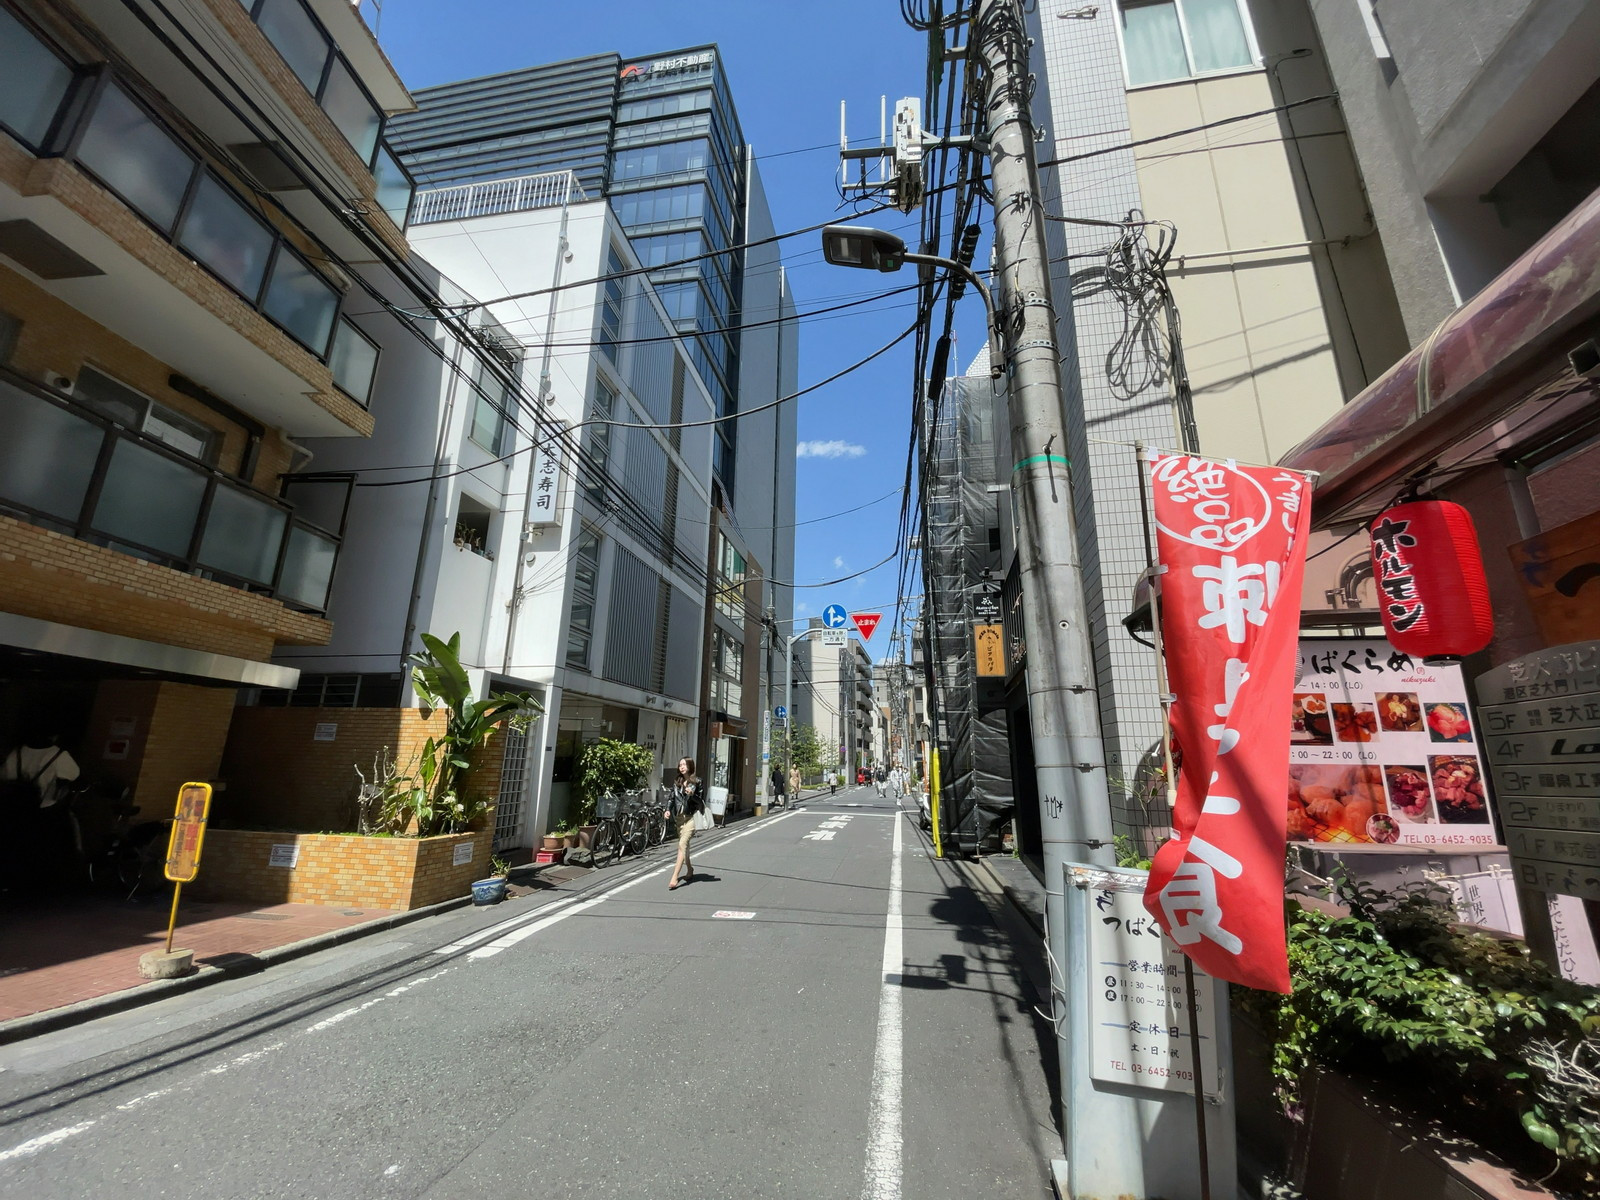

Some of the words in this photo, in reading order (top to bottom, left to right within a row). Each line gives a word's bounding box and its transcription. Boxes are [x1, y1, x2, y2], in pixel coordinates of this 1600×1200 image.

[654, 53, 710, 71] 野村不動産
[536, 442, 557, 510] 大志寿司
[1372, 517, 1425, 632] ホルモン
[857, 618, 876, 626] 止まれ
[1301, 648, 1415, 675] ばくらめ
[1487, 711, 1516, 730] 5F
[1496, 740, 1524, 758] 4F
[1501, 771, 1531, 791] 3F
[1509, 801, 1539, 821] 2F
[1403, 834, 1420, 844] TEL
[1424, 835, 1493, 844] 03-6452-9035
[1516, 832, 1545, 852] 1F
[1102, 917, 1170, 940] つばく
[1128, 959, 1178, 978] 営業時間
[1110, 1060, 1127, 1071] TEL
[1131, 1061, 1193, 1081] 03-6452-903
